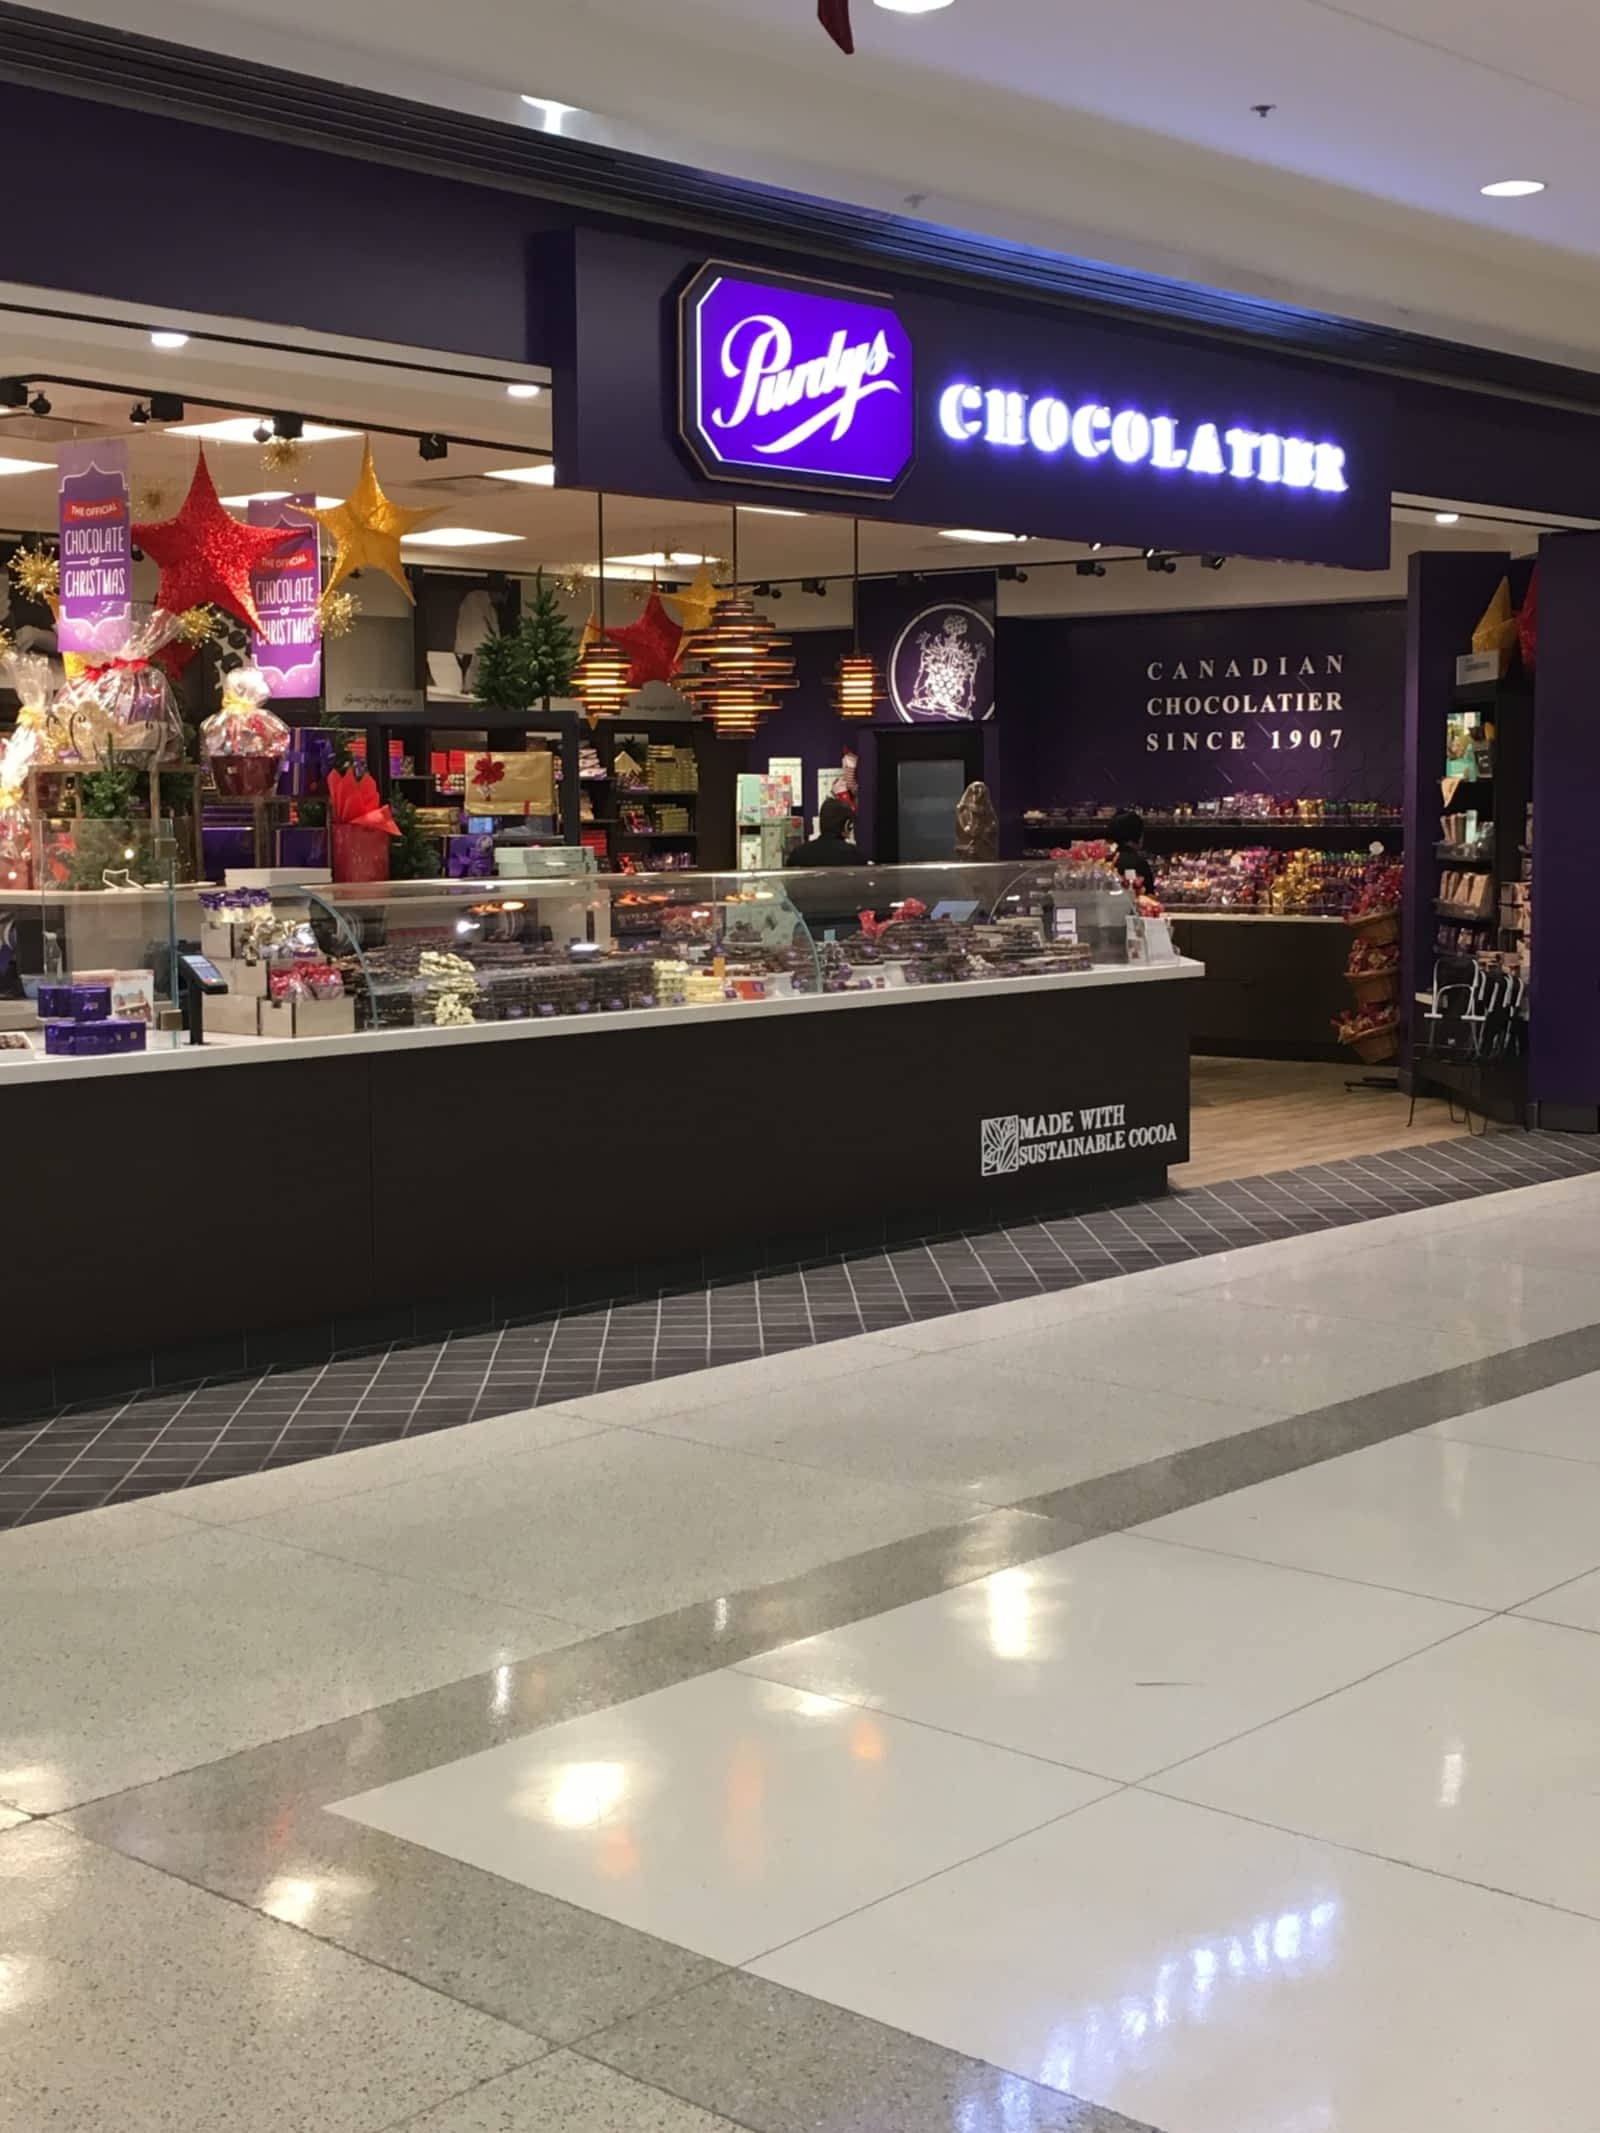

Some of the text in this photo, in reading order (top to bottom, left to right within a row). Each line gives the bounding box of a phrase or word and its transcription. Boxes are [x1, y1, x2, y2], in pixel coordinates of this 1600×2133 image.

[711, 314, 902, 454] Purdys
[939, 383, 1349, 492] CHOCOLATIER
[71, 502, 118, 517] THE OFFICIAL
[65, 526, 125, 556] CHOCOLATE
[89, 556, 101, 567] OF
[65, 567, 126, 598] CHRISTMAS
[255, 577, 314, 605] CHOCOLATE
[280, 606, 291, 617] OF
[1146, 655, 1343, 681] CANADIAN
[1146, 692, 1343, 715] CHOCOLATIER
[1146, 729, 1343, 752] SINCE 1907
[1019, 1104, 1125, 1140] MADE WITH
[1019, 1122, 1177, 1166] SUSTAINABLE COCOA
